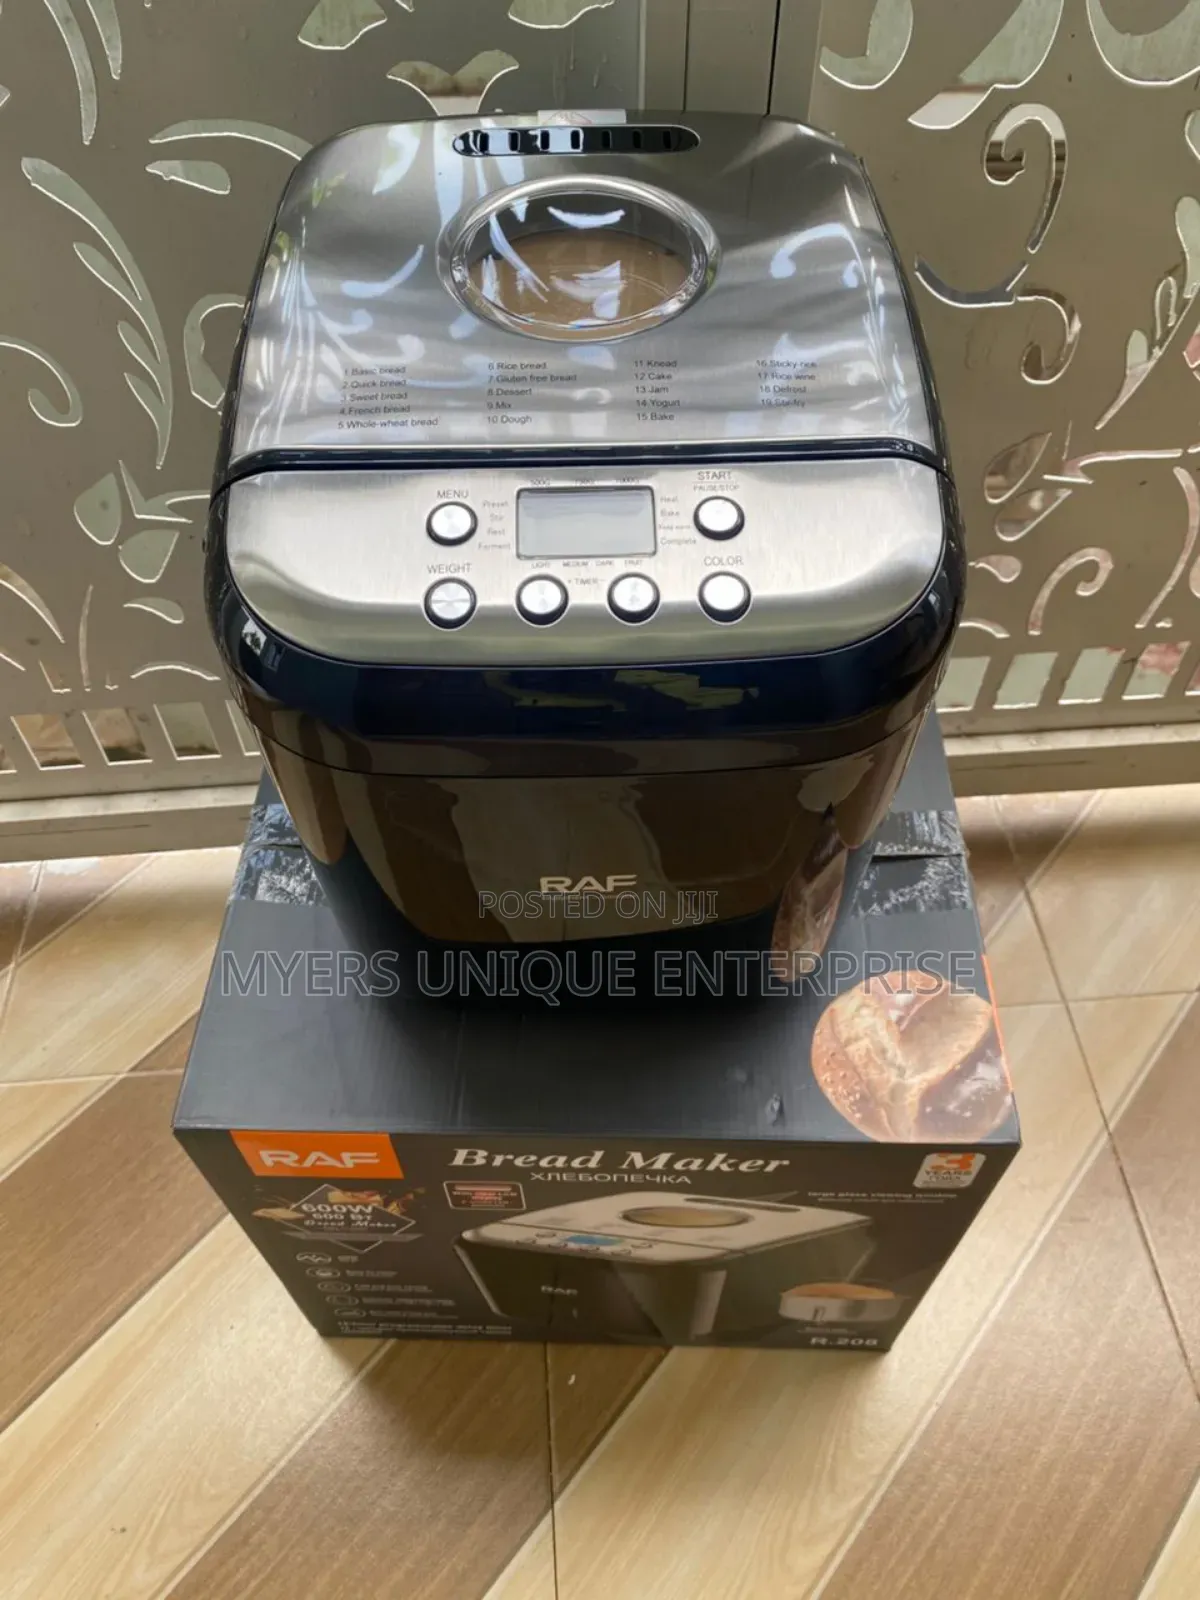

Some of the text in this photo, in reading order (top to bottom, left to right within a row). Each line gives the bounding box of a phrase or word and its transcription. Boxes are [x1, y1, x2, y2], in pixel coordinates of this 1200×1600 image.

[697, 471, 732, 481] START
[436, 490, 470, 499] MENU
[703, 555, 744, 567] COLOR
[427, 563, 472, 574] WEIGHT
[539, 874, 637, 894] RAF
[259, 1150, 380, 1168] RAF
[449, 1148, 791, 1173] Bread Maker
[530, 1171, 693, 1185] ХЛЕБОПЕЧКА
[301, 1203, 373, 1213] 600W
